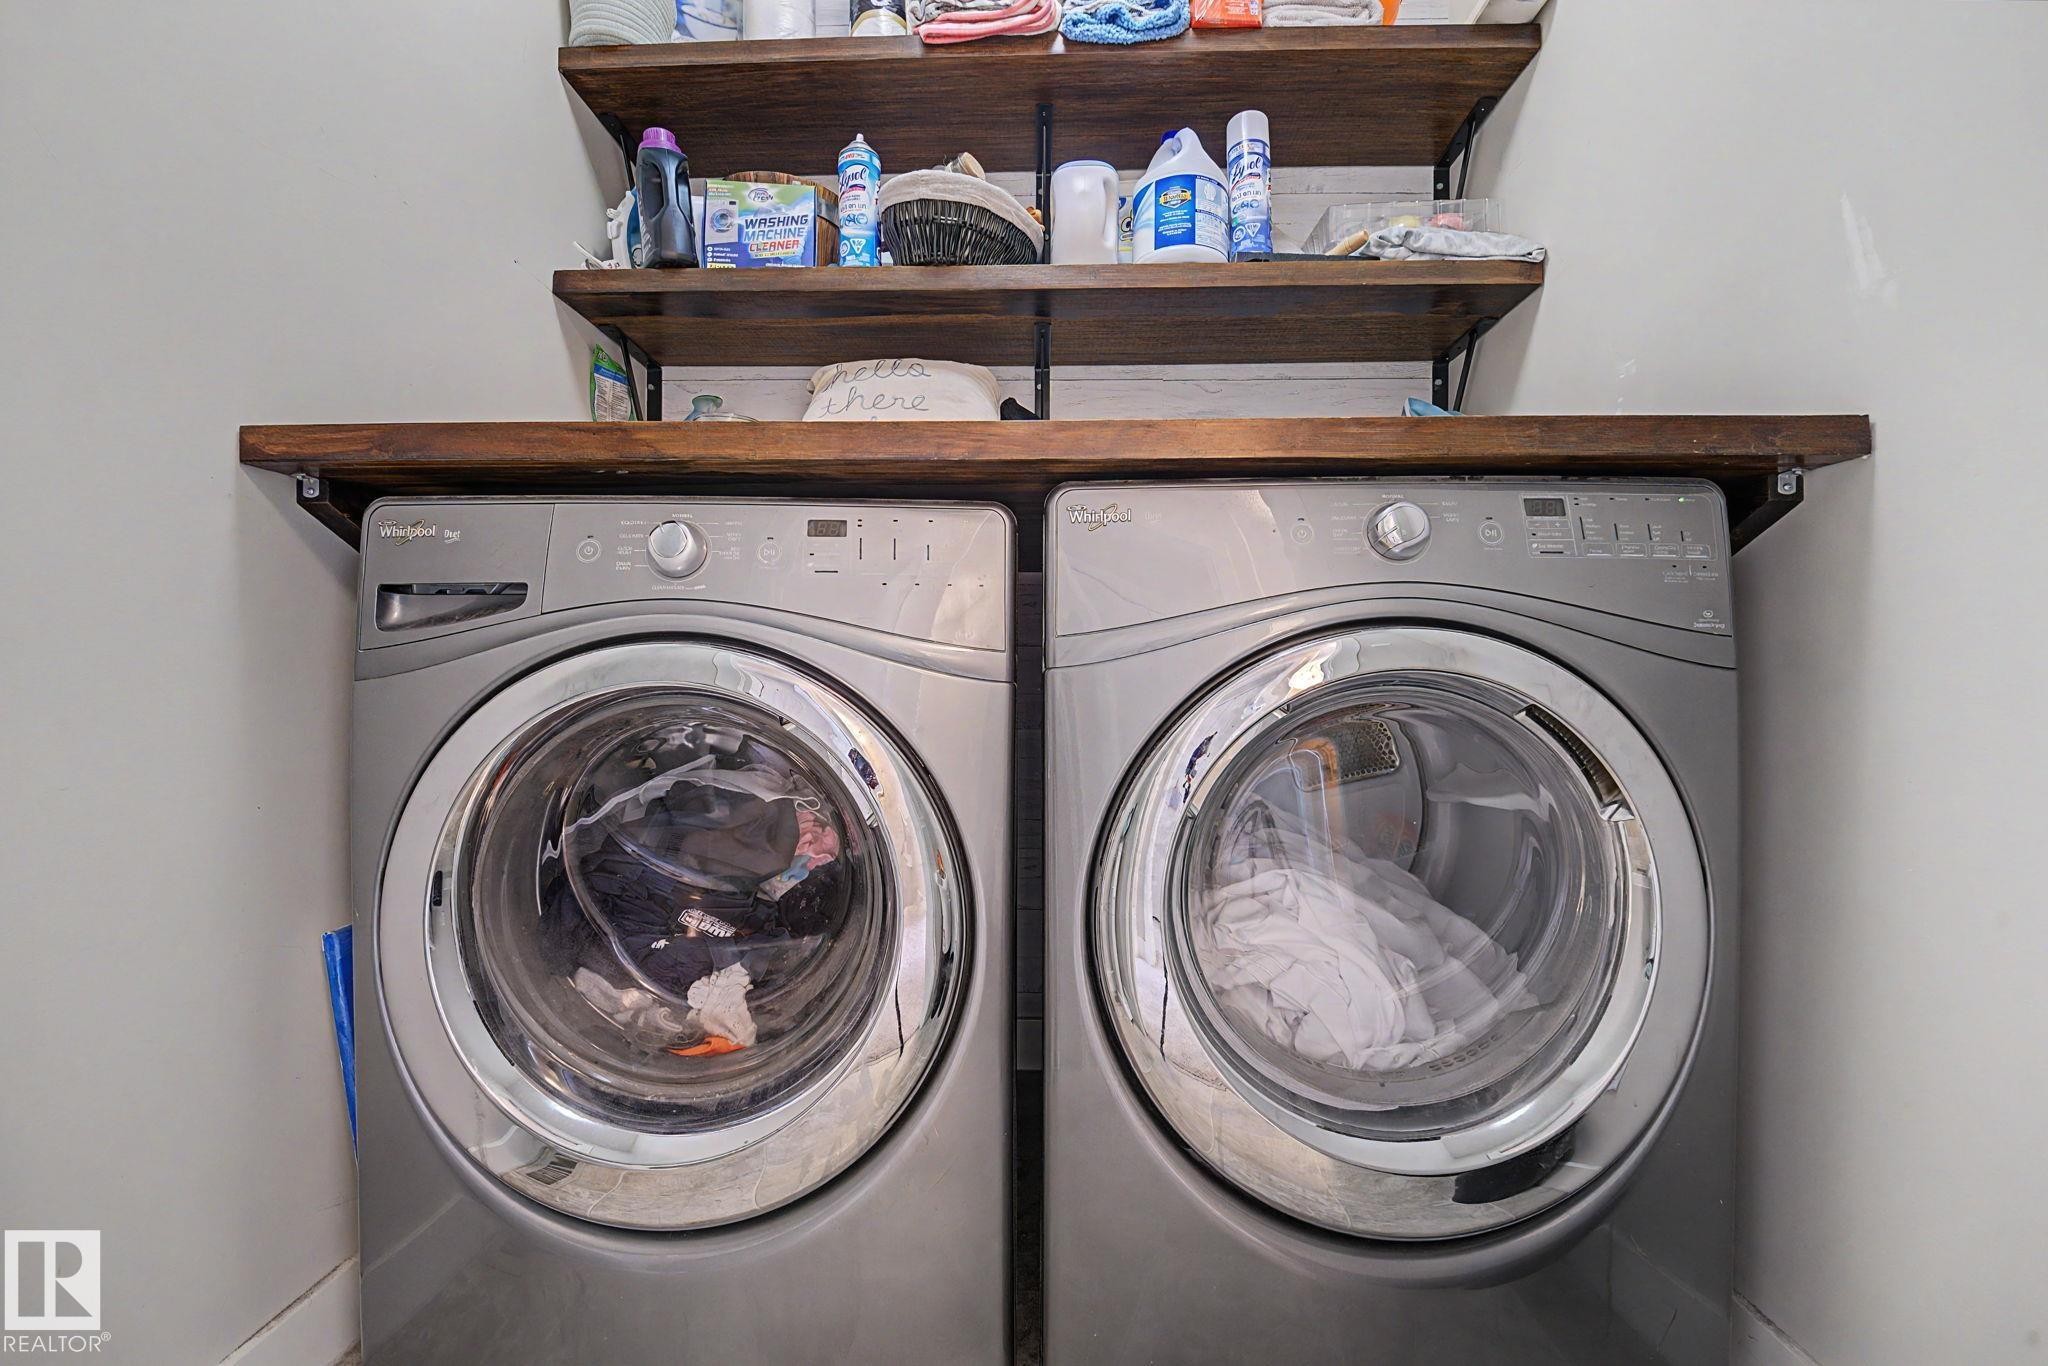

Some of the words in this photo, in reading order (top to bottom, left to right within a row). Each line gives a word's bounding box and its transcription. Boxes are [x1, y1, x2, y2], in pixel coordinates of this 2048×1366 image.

[840, 167, 867, 192] Lysol
[744, 214, 809, 230] WASHING
[743, 227, 806, 242] MACHINE
[749, 239, 800, 252] CLEANER
[821, 359, 931, 393] hello
[818, 386, 929, 418] there
[1068, 508, 1131, 526] Whirlpool
[379, 524, 436, 541] Whirlpool
